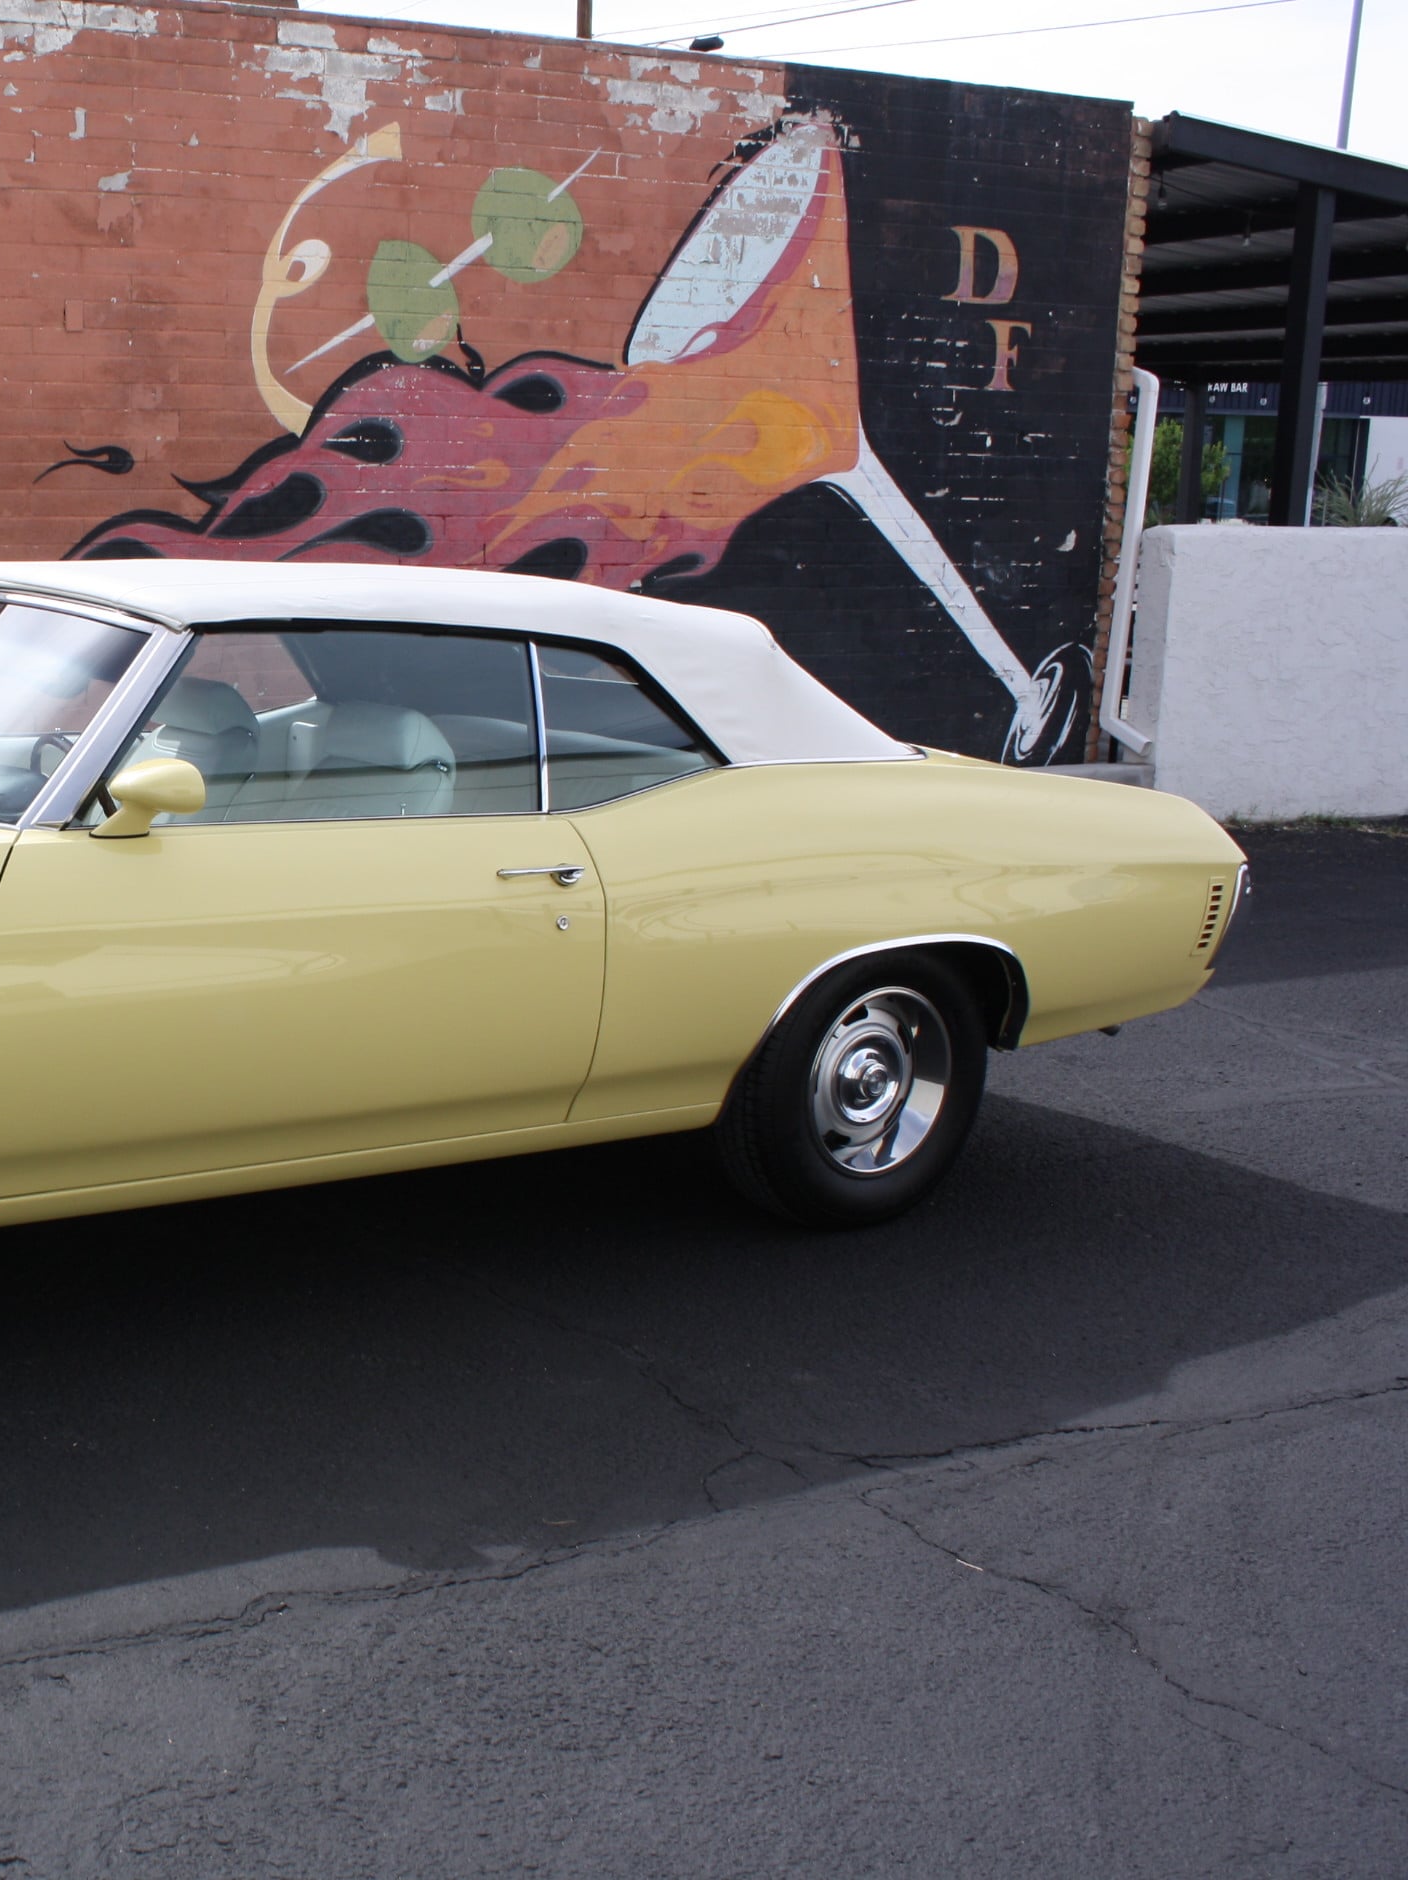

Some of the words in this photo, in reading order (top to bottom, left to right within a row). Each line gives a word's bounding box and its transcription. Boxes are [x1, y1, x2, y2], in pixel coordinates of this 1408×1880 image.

[940, 225, 1019, 305] D
[984, 318, 1032, 392] F
[1230, 382, 1248, 393] BAR
